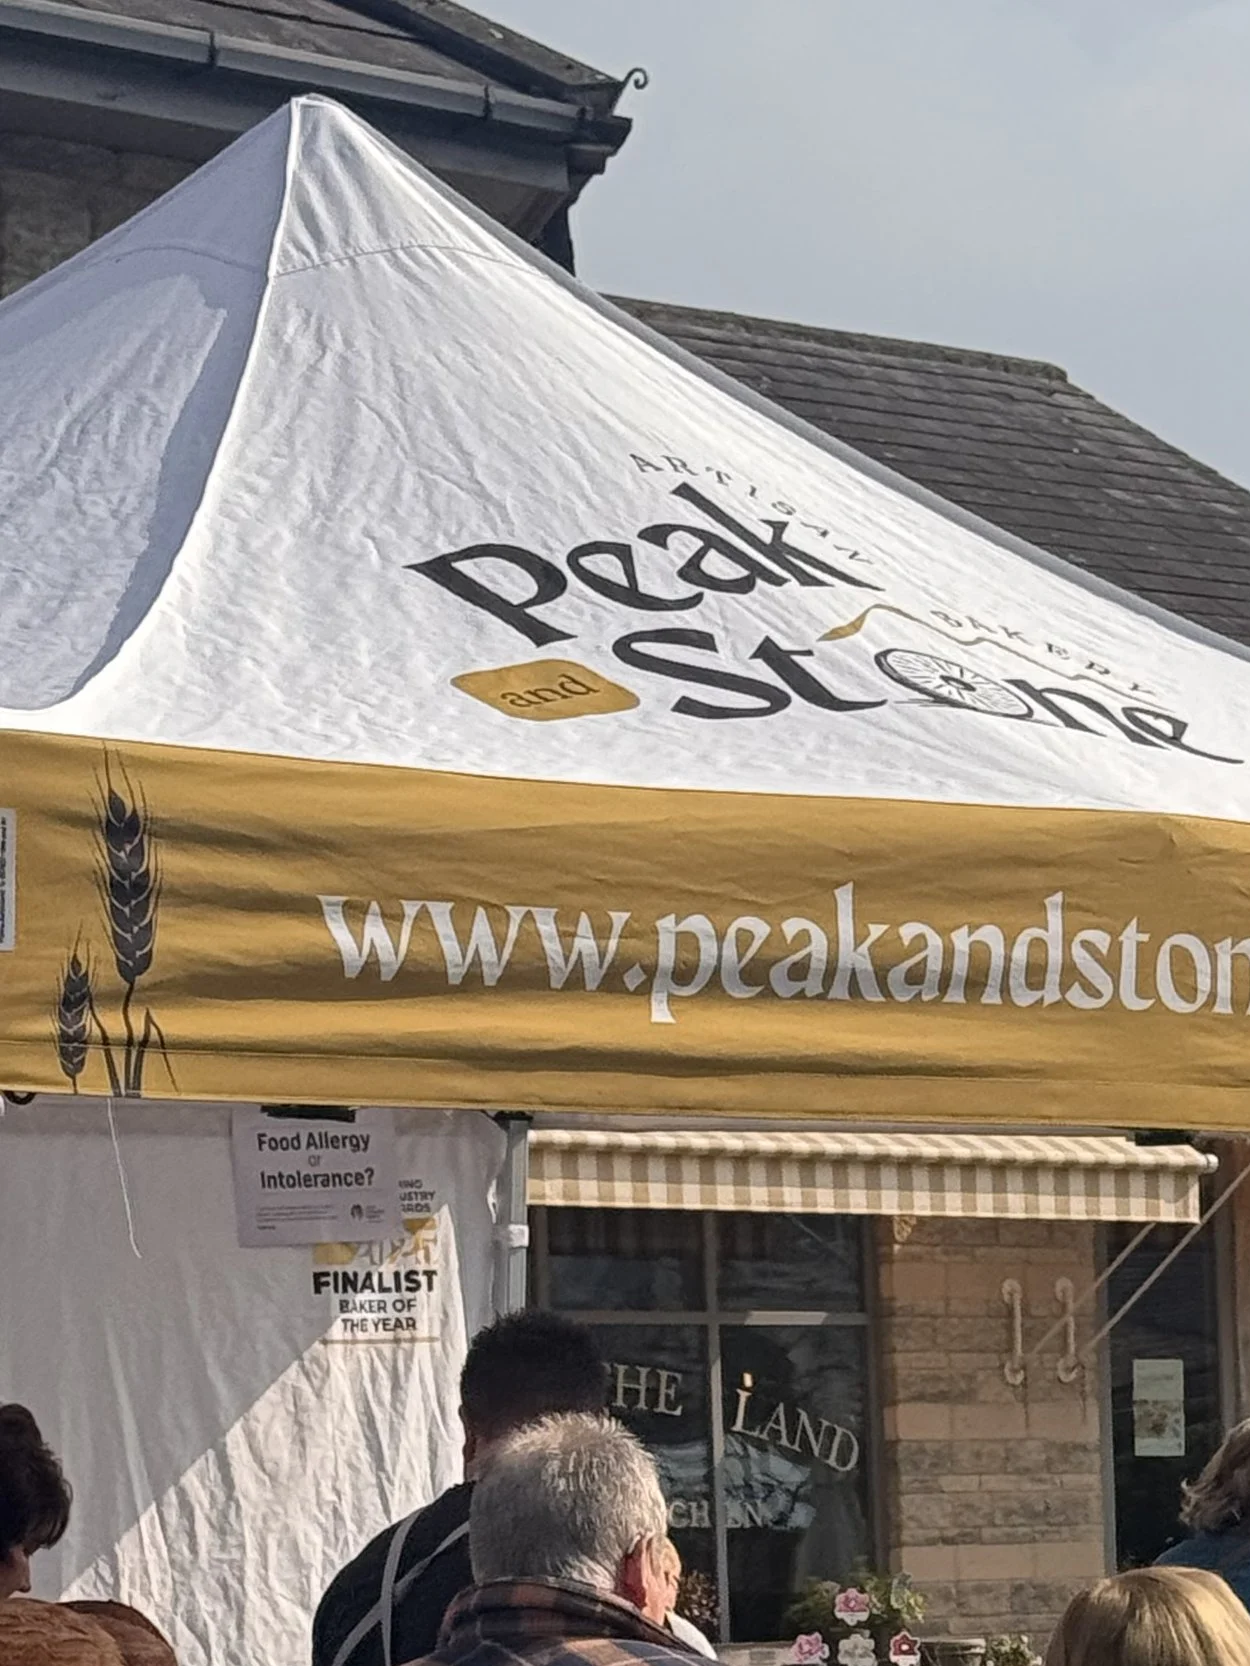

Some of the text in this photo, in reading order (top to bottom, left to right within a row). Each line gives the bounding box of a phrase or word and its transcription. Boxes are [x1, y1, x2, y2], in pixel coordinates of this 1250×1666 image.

[629, 453, 874, 565] ARTISAN
[404, 482, 886, 648] Peak
[929, 609, 1158, 697] BAKERY
[500, 627, 1244, 765] and Stone
[257, 1131, 371, 1153] Food Allergy
[307, 1154, 323, 1168] or
[259, 1166, 376, 1189] Intolerance?
[398, 1178, 424, 1190] ING
[399, 1190, 437, 1201] USTRY
[400, 1202, 432, 1214] ARDS
[312, 1269, 438, 1295] FINALIST
[338, 1298, 418, 1314] BAKER OF
[341, 1317, 418, 1334] THE YEAR
[600, 1361, 860, 1473] HE LAND
[667, 1498, 769, 1530] CHEN
